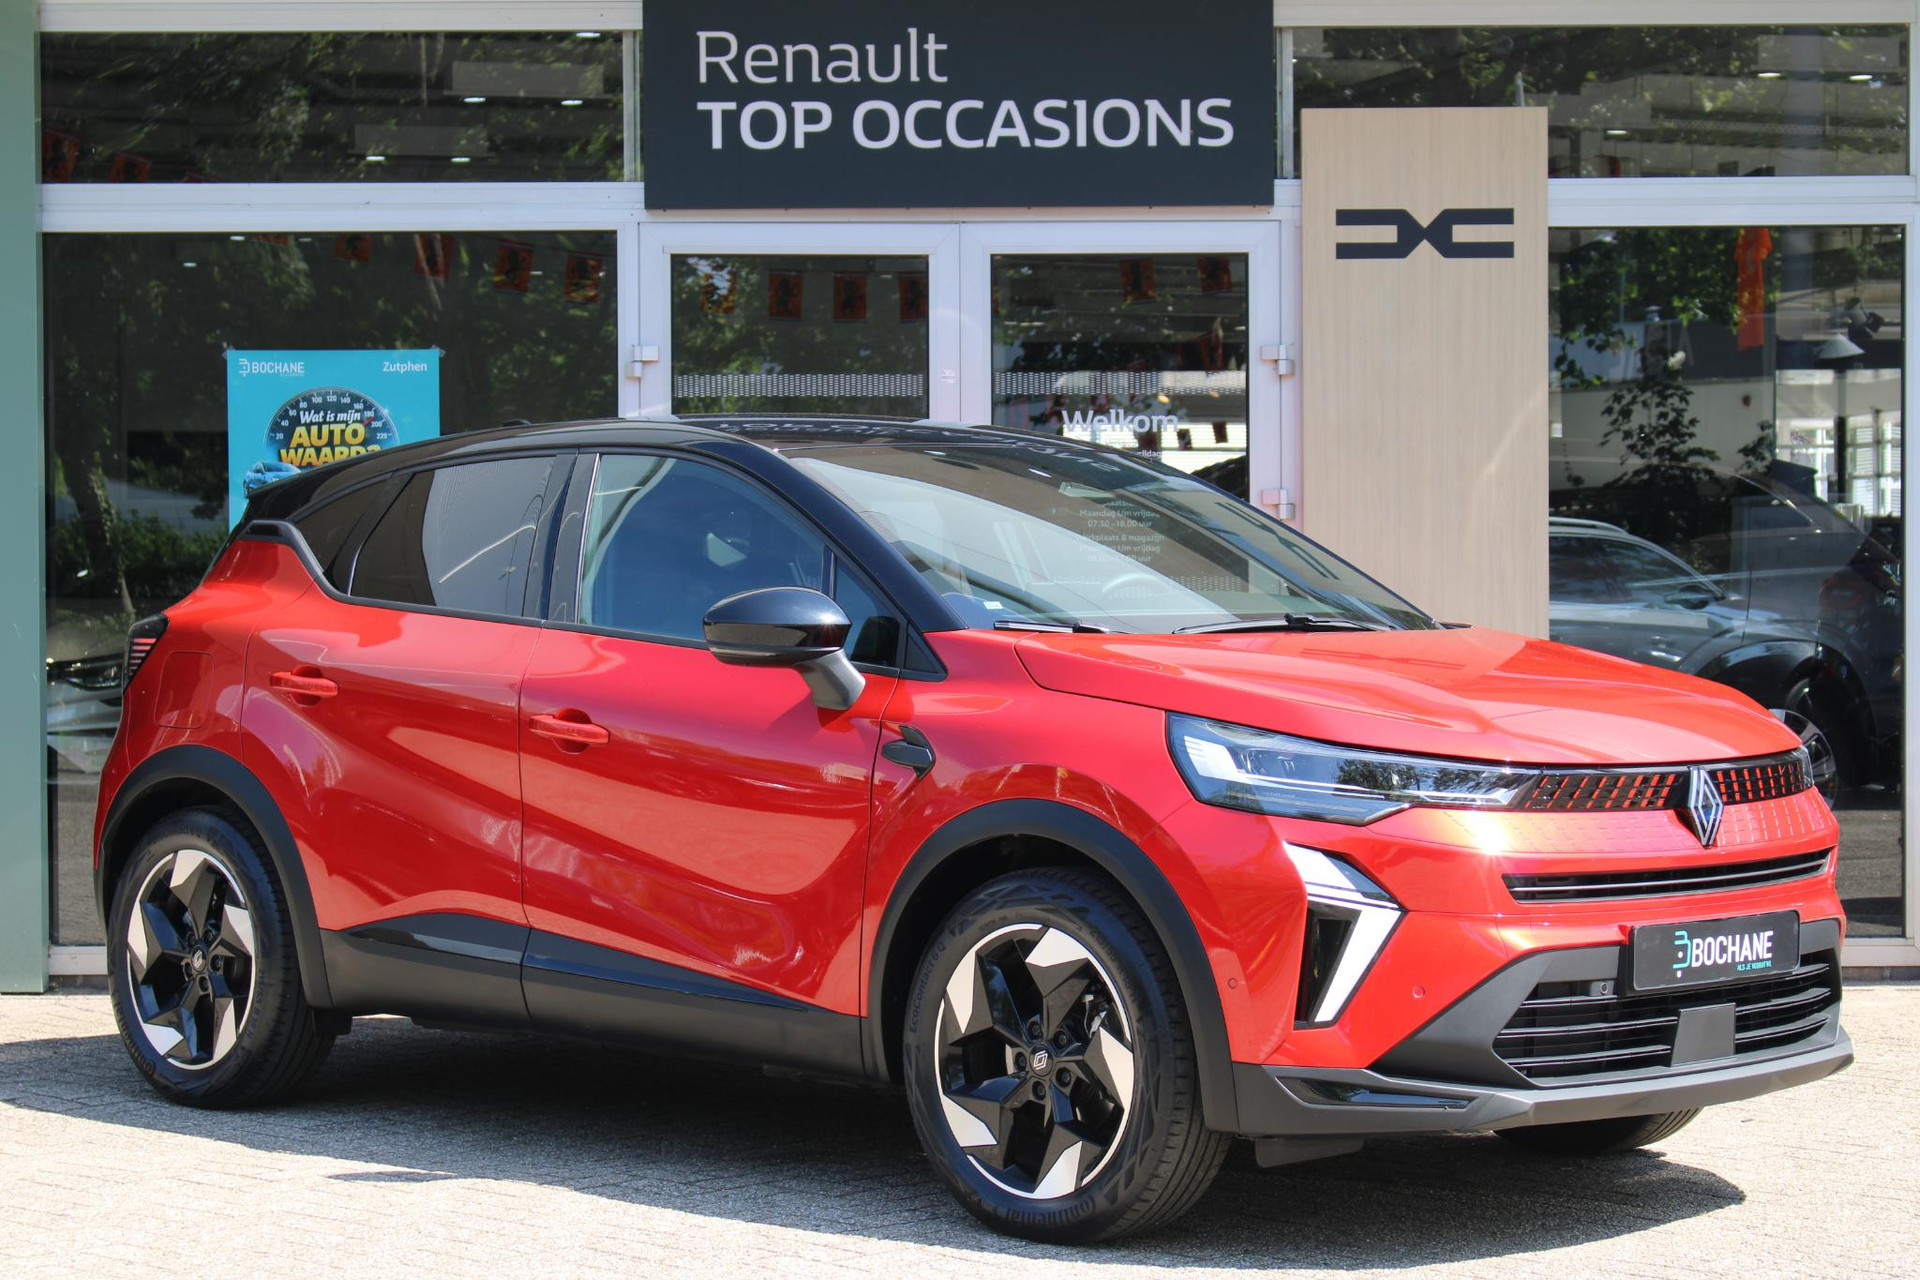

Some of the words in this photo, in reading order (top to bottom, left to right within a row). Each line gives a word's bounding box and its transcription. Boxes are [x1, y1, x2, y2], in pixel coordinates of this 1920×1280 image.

[696, 27, 949, 84] Renault
[696, 100, 833, 150] TOP
[851, 98, 1235, 150] OCCASIONS
[251, 361, 305, 374] BOCHANE
[382, 361, 428, 374] Zutphen
[300, 410, 324, 424] Wat
[326, 410, 335, 422] is
[336, 410, 361, 424] mijn
[1061, 408, 1179, 433] Welkom
[289, 423, 366, 448] AUTO
[1691, 931, 1774, 968] BOCHANE
[908, 959, 936, 1034] EcoContact
